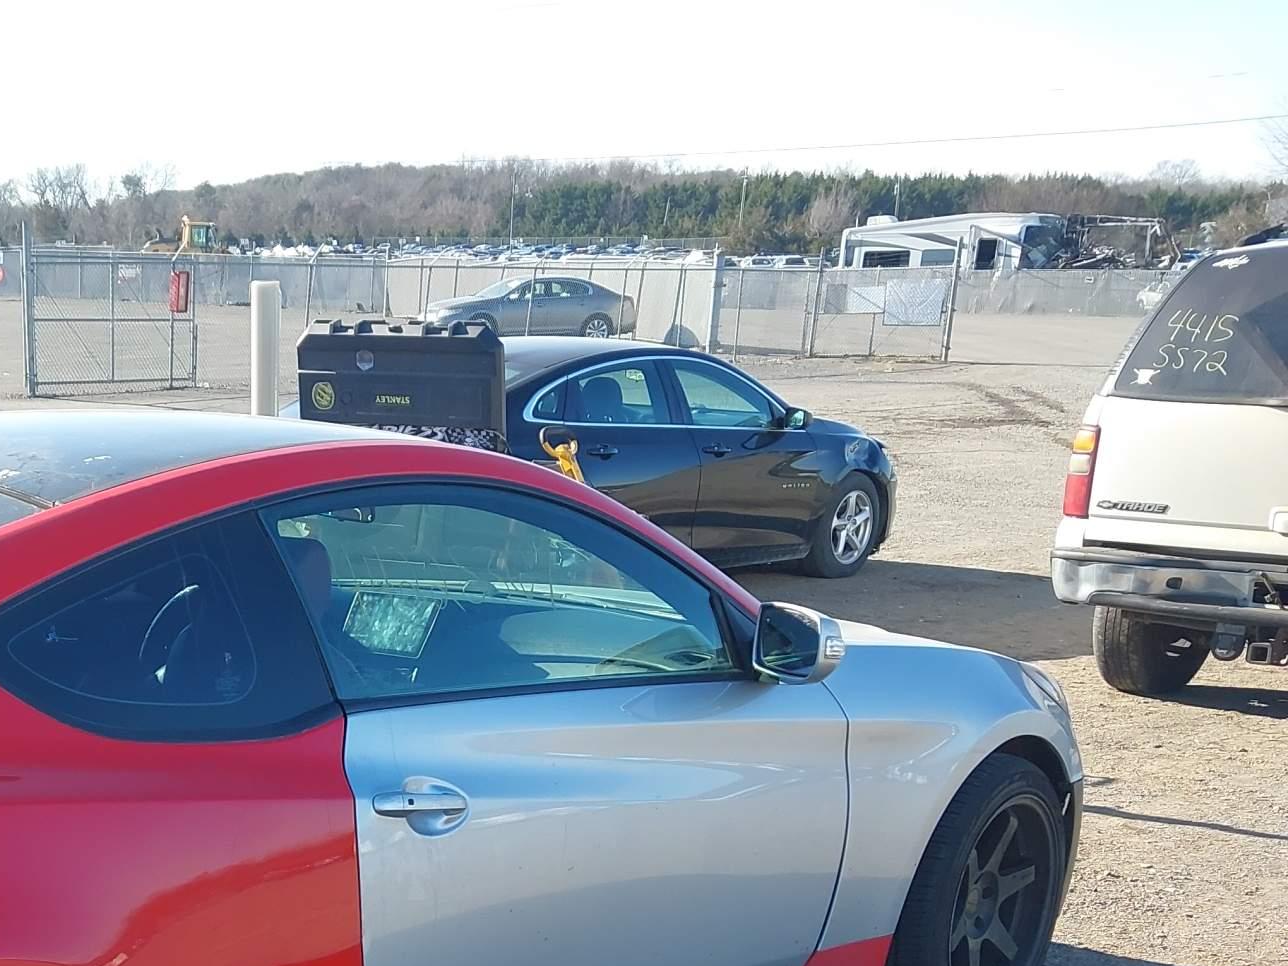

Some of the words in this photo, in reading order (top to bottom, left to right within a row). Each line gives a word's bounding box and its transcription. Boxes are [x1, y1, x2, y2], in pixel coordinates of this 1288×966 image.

[1167, 308, 1240, 343] 4415
[1153, 344, 1228, 376] 5572
[375, 395, 410, 405] STANLEY
[1116, 501, 1169, 514] TAHOE
